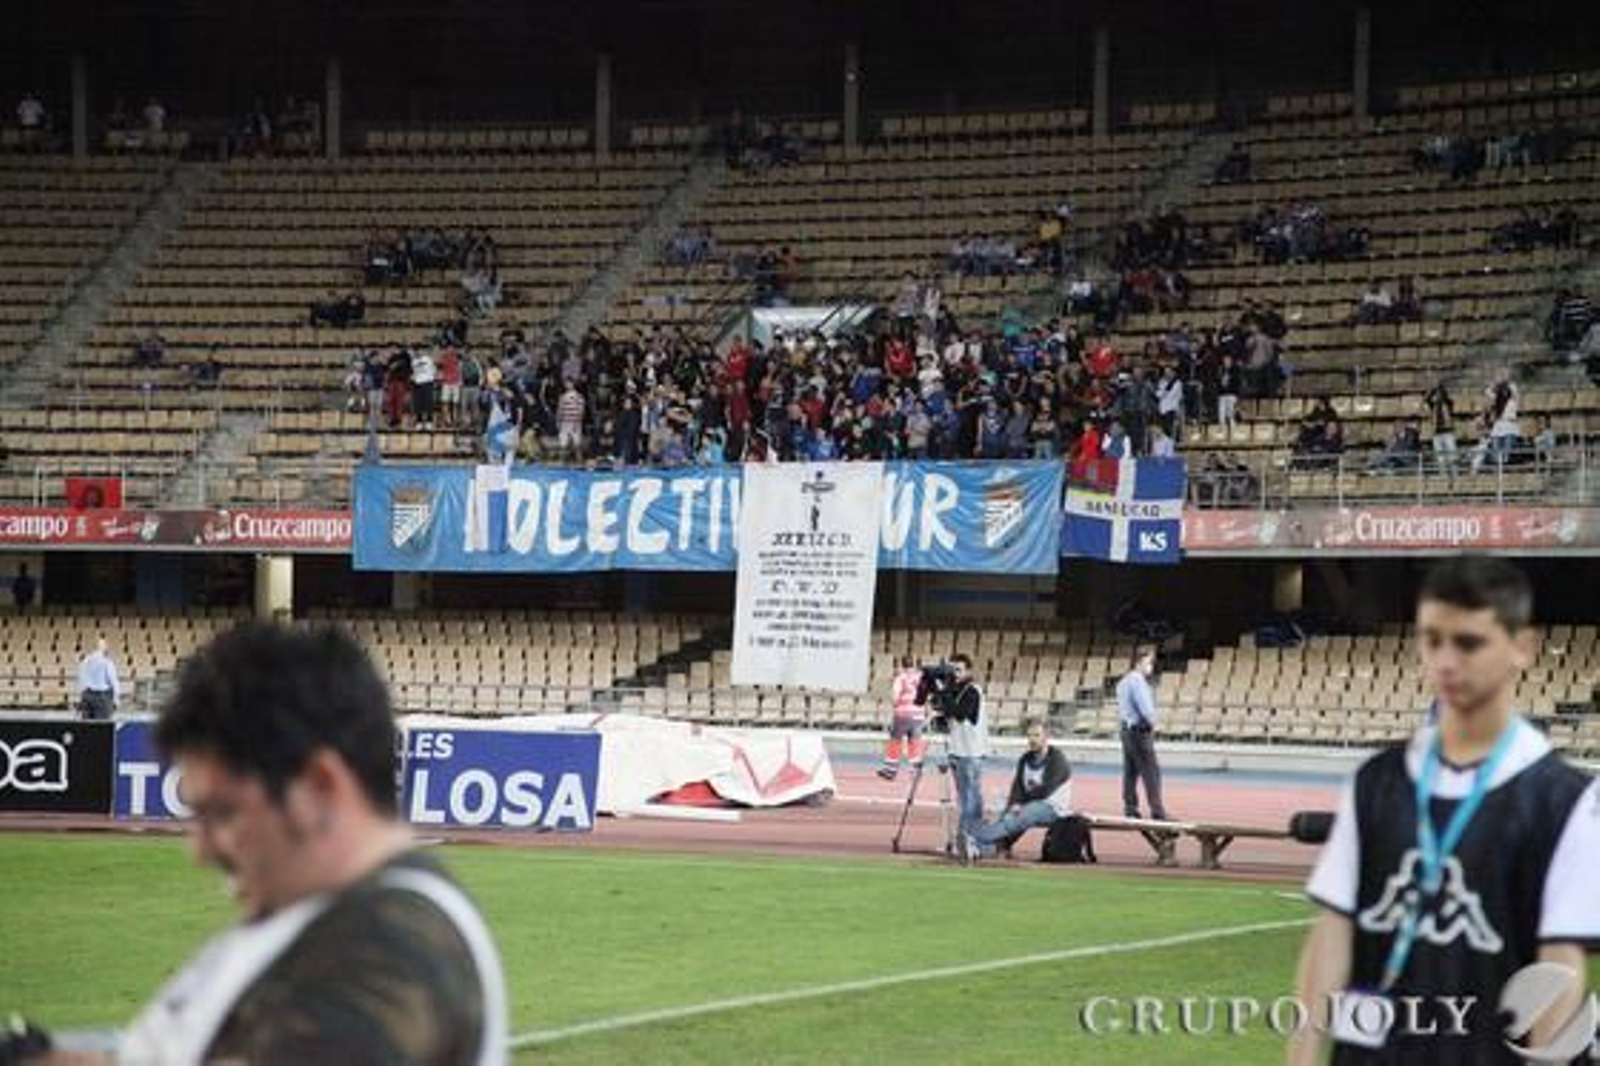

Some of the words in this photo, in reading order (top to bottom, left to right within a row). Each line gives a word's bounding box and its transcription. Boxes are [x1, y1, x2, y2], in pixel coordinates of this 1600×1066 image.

[235, 513, 352, 542] Cruzcampo
[1355, 511, 1481, 545] Cruzcampo
[410, 768, 591, 829] LOSA
